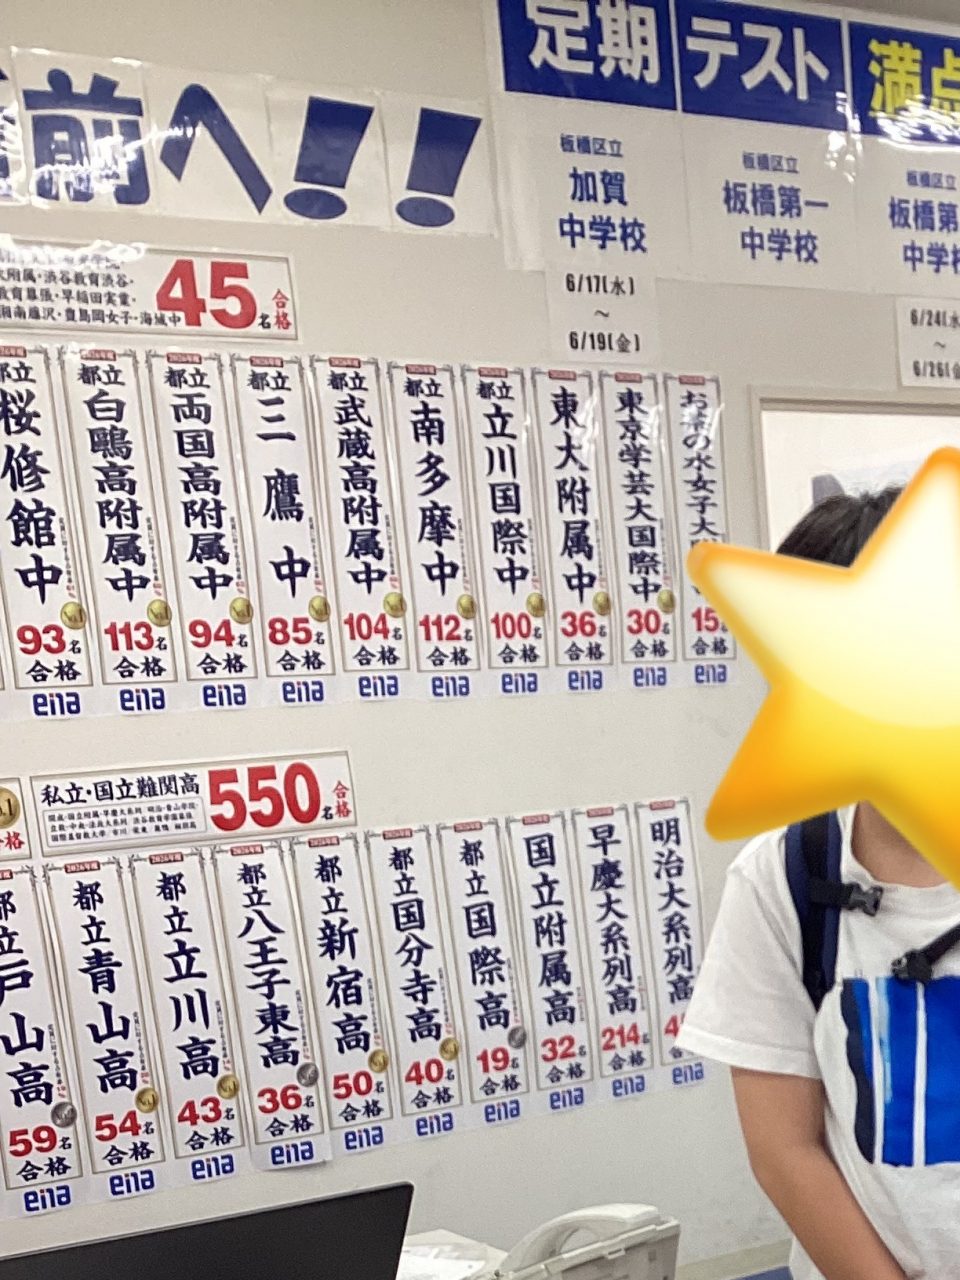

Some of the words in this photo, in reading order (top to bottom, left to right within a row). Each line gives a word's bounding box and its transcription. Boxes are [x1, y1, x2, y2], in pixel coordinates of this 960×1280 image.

[525, 0, 660, 85] 定期
[686, 17, 831, 102] テスト
[0, 68, 482, 228] 前へ!!
[560, 133, 624, 158] 板橋区立
[742, 150, 799, 174] 板橋区立
[569, 166, 628, 206] 加賀
[906, 169, 957, 191] 板橋区立
[723, 179, 829, 218] 板橋第一
[558, 211, 648, 254] 中学校
[741, 226, 818, 263] 中学校
[155, 258, 272, 330] 45名
[565, 272, 635, 296] 6/17(水)
[272, 288, 293, 331] 合格
[569, 331, 640, 353] 6/19(金)
[77, 363, 126, 387] 都立
[164, 366, 211, 389] 都立
[247, 370, 292, 391] 都立
[327, 370, 369, 392] 都立
[403, 377, 444, 398] 都立
[476, 380, 515, 401] 都立
[0, 388, 62, 605] 桜修館中
[169, 393, 234, 600] 両国高附属中
[256, 396, 311, 598] 三鷹中
[333, 393, 388, 594] 武蔵高附属中
[409, 400, 460, 596] 南多摩中
[482, 403, 530, 595] 立川国際中
[549, 386, 599, 604] 東大附属中
[614, 388, 664, 602] 東京学芸大国際中
[16, 623, 82, 655] 93名
[104, 621, 168, 651] 113名
[188, 619, 248, 649] 94名
[268, 617, 325, 645] 85名
[343, 613, 402, 641] 104名
[419, 614, 473, 641] 112名
[353, 645, 400, 666] 合格
[427, 646, 471, 667] 合格
[498, 643, 541, 664] 合格
[564, 641, 606, 661] 合格
[630, 639, 670, 658] 合格
[692, 636, 728, 655] 合格
[26, 659, 81, 682] 合格
[113, 656, 167, 679] 合格
[196, 652, 249, 675] 合格
[276, 649, 326, 671] 合格
[358, 675, 399, 697] ena
[501, 672, 538, 693] ena
[567, 670, 603, 690] ena
[633, 667, 667, 687] ena
[695, 664, 727, 683] ena
[119, 687, 166, 711] ena
[202, 684, 247, 707] ena
[282, 680, 324, 703] ena
[431, 676, 470, 697] ena
[32, 692, 81, 716] ena
[41, 772, 200, 807] 私立・国立難関高
[208, 762, 334, 832] 550名
[333, 780, 352, 818] 合格
[587, 824, 638, 1015] 早慶大系列高
[651, 817, 695, 1004] 明治大系列高
[460, 839, 511, 1030] 都立国際高
[523, 833, 577, 1026] 国立附属高
[315, 855, 371, 1054] 都立新宿高
[388, 847, 442, 1043] 都立国分寺高
[156, 871, 220, 1080] 都立立川高
[237, 862, 299, 1068] 都立八王子東高
[73, 880, 138, 1093] 都立青山高
[664, 1014, 685, 1037] 4
[404, 1058, 455, 1086] 40名
[545, 1062, 585, 1083] 合格
[609, 1050, 646, 1071] 合格
[672, 1062, 704, 1084] ena
[333, 1070, 384, 1099] 50名
[479, 1074, 521, 1096] 合格
[612, 1075, 645, 1097] ena
[257, 1084, 315, 1114] 36名
[411, 1086, 454, 1109] 合格
[550, 1087, 584, 1110] ena
[177, 1096, 235, 1126] 43名
[338, 1099, 384, 1122] 合格
[484, 1099, 520, 1123] ena
[95, 1110, 155, 1142] 54名
[265, 1114, 314, 1138] 合格
[416, 1112, 454, 1136] ena
[9, 1126, 72, 1157] 59名
[185, 1126, 235, 1151] 合格
[344, 1126, 383, 1150] ena
[102, 1140, 155, 1166] 合格
[271, 1141, 314, 1165] ena
[16, 1156, 72, 1182] 合格
[191, 1154, 234, 1180] ena
[109, 1169, 155, 1196] ena
[24, 1185, 71, 1212] ena
